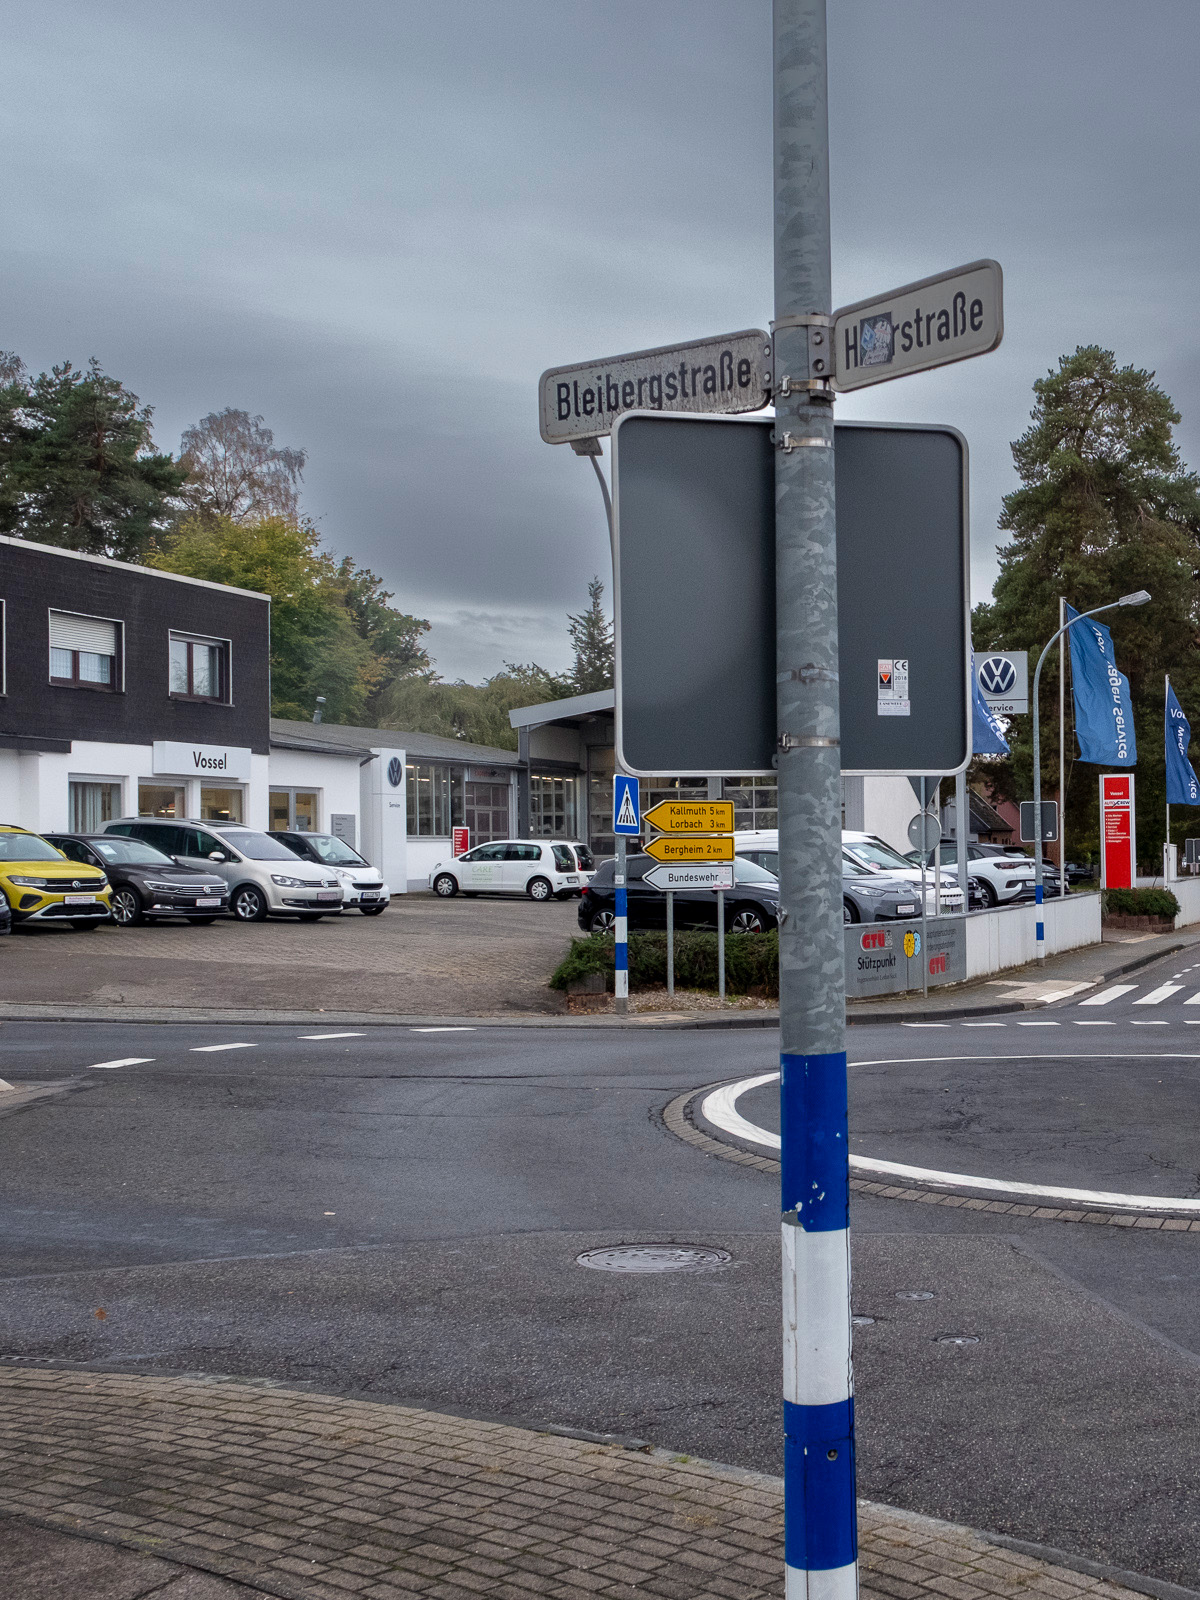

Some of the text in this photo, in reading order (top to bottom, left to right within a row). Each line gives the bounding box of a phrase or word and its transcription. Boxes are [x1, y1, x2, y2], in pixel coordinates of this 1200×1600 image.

[844, 290, 984, 370] Hrstraße
[556, 350, 752, 421] Bleibergstraße
[988, 703, 1014, 712] ervice
[192, 751, 227, 770] Vossel
[670, 806, 706, 815] Kallmuth
[709, 806, 715, 815] 5
[670, 820, 703, 828] Lorbach
[709, 820, 715, 828] 3
[664, 845, 703, 856] Bergheim
[706, 845, 712, 853] 2
[668, 872, 719, 882] Bundeswehr
[862, 929, 885, 949] GTÜ
[857, 953, 896, 972] Stützpunkt
[929, 952, 946, 975] GTÜ
